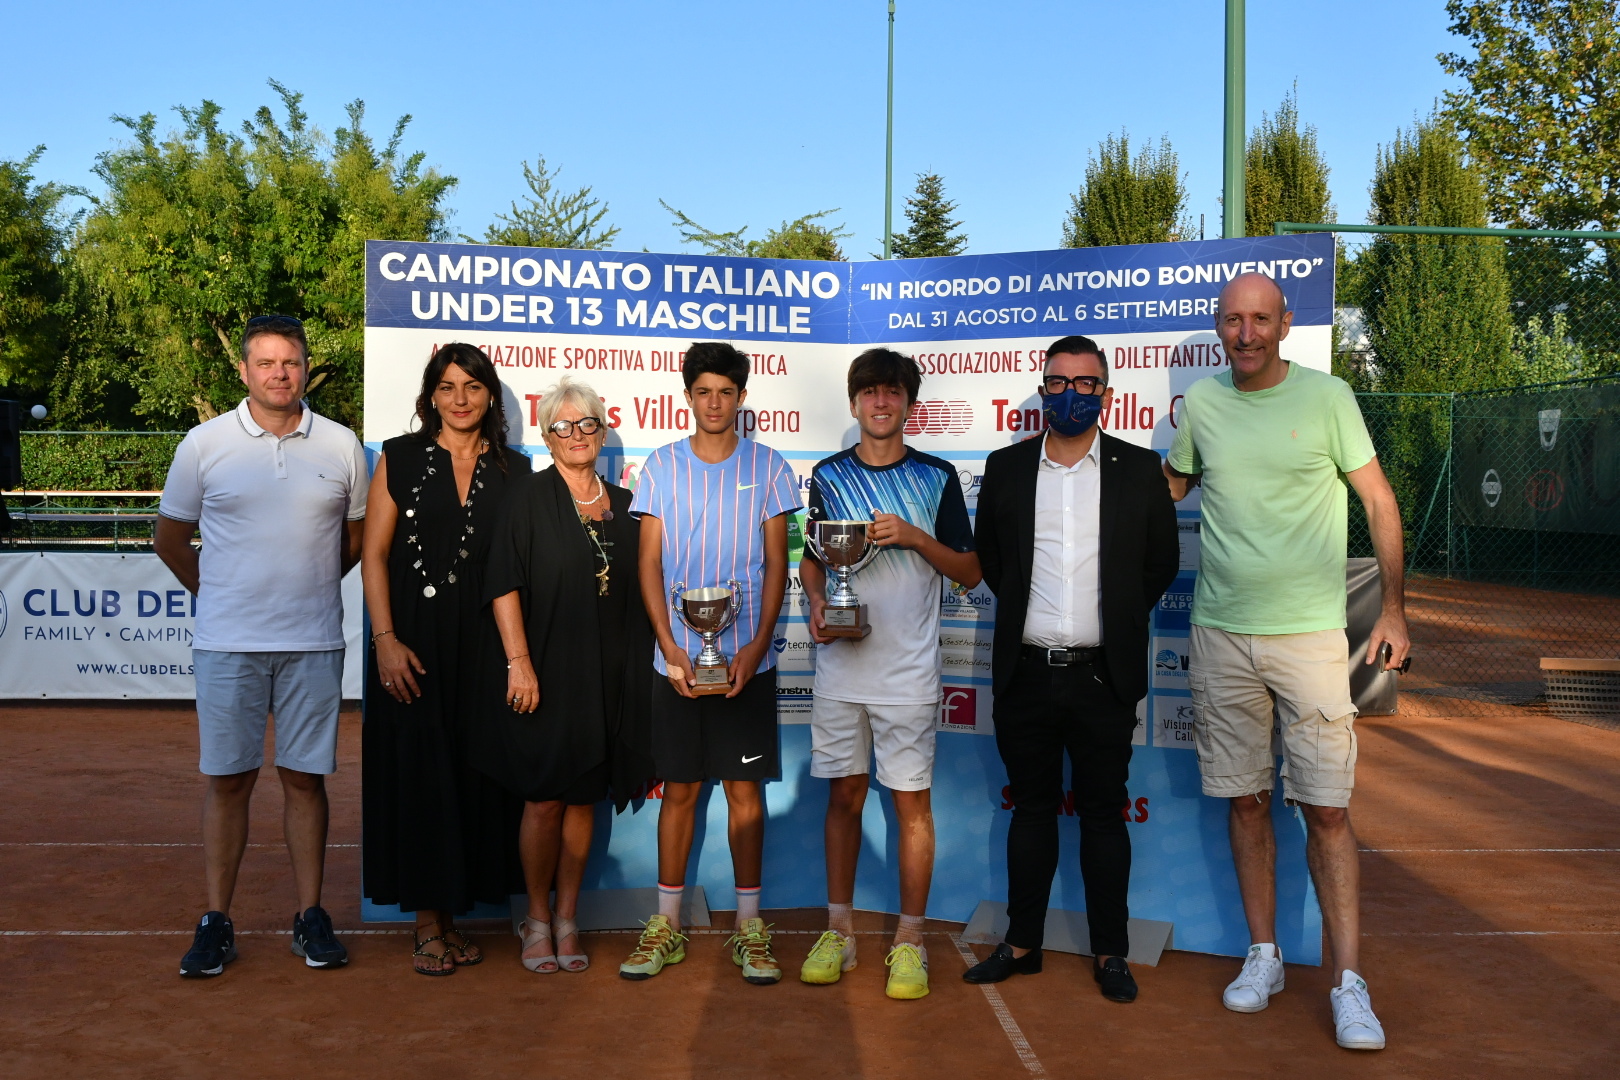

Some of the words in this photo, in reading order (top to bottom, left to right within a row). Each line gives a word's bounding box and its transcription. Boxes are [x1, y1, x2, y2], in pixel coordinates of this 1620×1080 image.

[379, 252, 651, 291] CAMPIONATO
[664, 264, 840, 299] ITALIANO
[899, 277, 1001, 299] RICORDO
[1008, 274, 1031, 293] DI
[1038, 268, 1150, 292] ANTONIO
[411, 290, 554, 325] UNDER
[566, 297, 604, 326] 13
[616, 299, 811, 334] MASCHILE
[888, 312, 925, 329] DAL
[931, 311, 948, 327] 31
[954, 307, 1037, 326] AGOSTO
[1042, 305, 1069, 322] AL
[1074, 304, 1087, 320] 6
[1093, 298, 1219, 320] SETTEMBRE
[563, 348, 645, 371] SPORTIVA
[633, 394, 689, 430] Villa
[736, 409, 800, 438] rpena
[23, 588, 122, 618] CLUB
[966, 592, 992, 606] Sole
[24, 626, 96, 641] FAMILY
[119, 627, 194, 642] CAMPIN
[943, 637, 991, 651] Gestholding
[76, 663, 195, 675] WWW.CLUBDELS
[942, 656, 992, 671] Gestholding
[941, 723, 977, 731] FONDAZIONE
[1163, 718, 1193, 731] Vision
